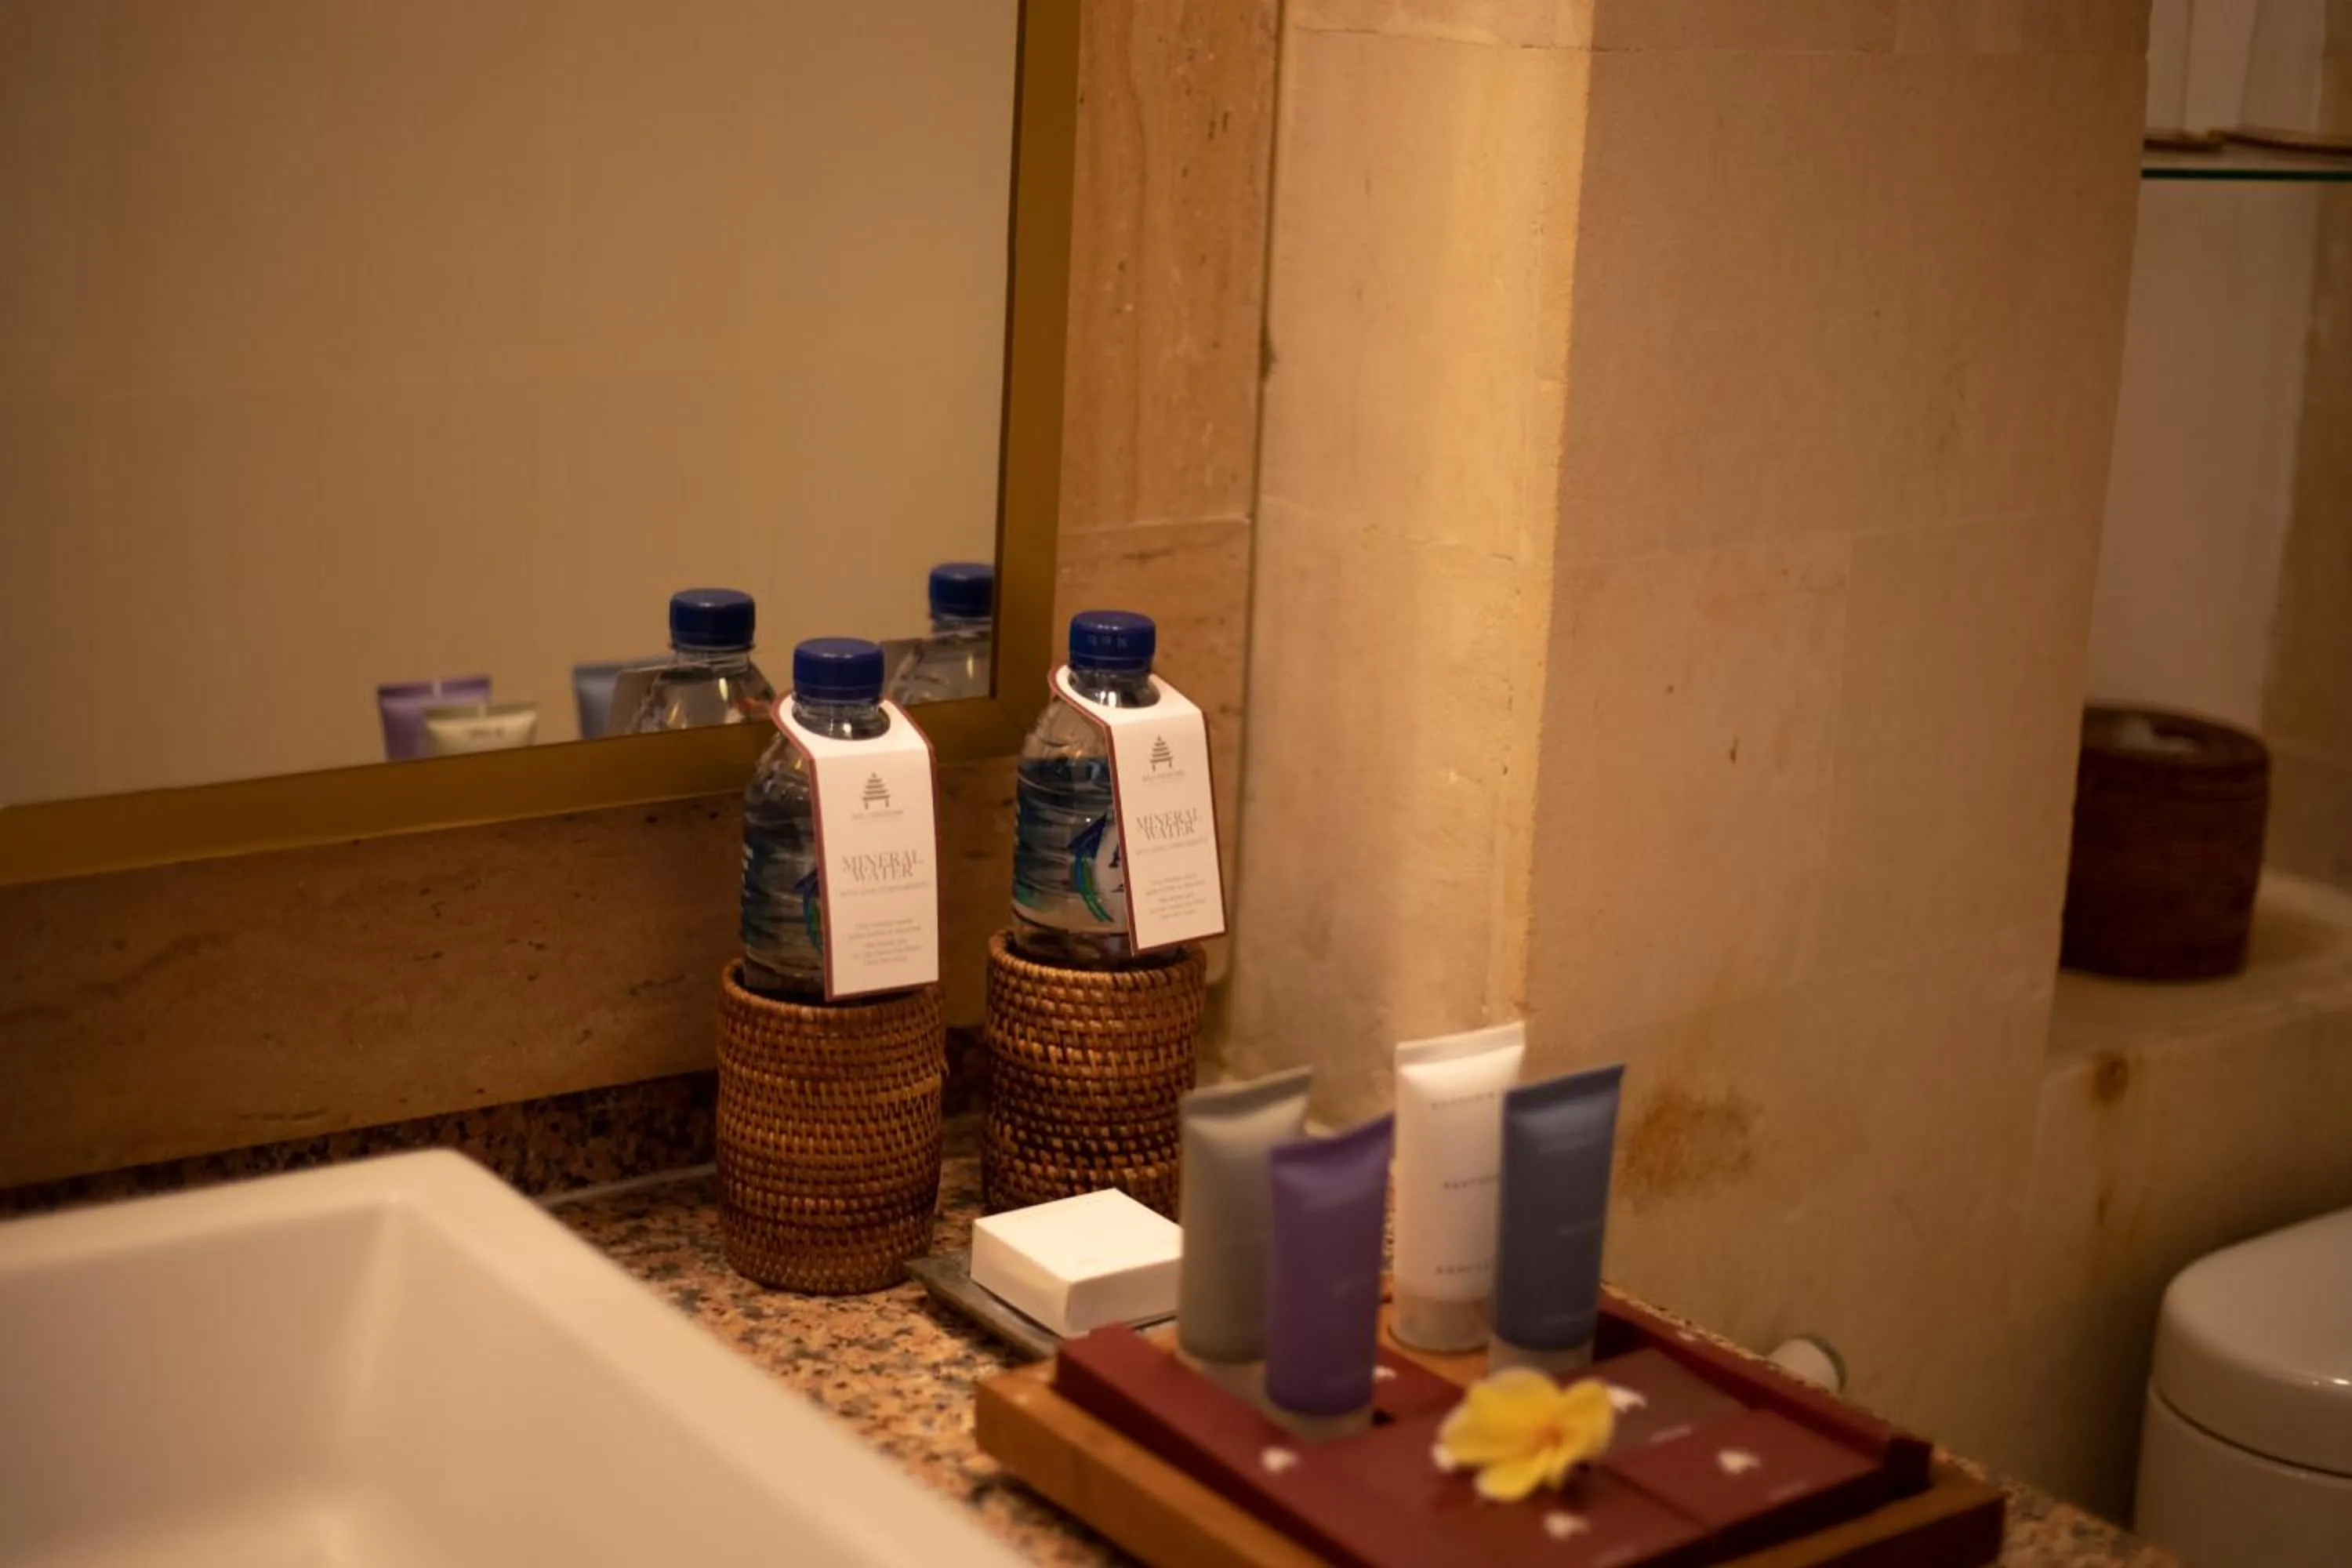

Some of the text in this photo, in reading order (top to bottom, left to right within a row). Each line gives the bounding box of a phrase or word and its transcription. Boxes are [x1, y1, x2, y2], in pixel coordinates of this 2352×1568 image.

[1136, 808, 1203, 831] MINERAL
[1144, 821, 1195, 841] WATER
[842, 849, 924, 873] MINERAL
[852, 862, 914, 884] WATER
